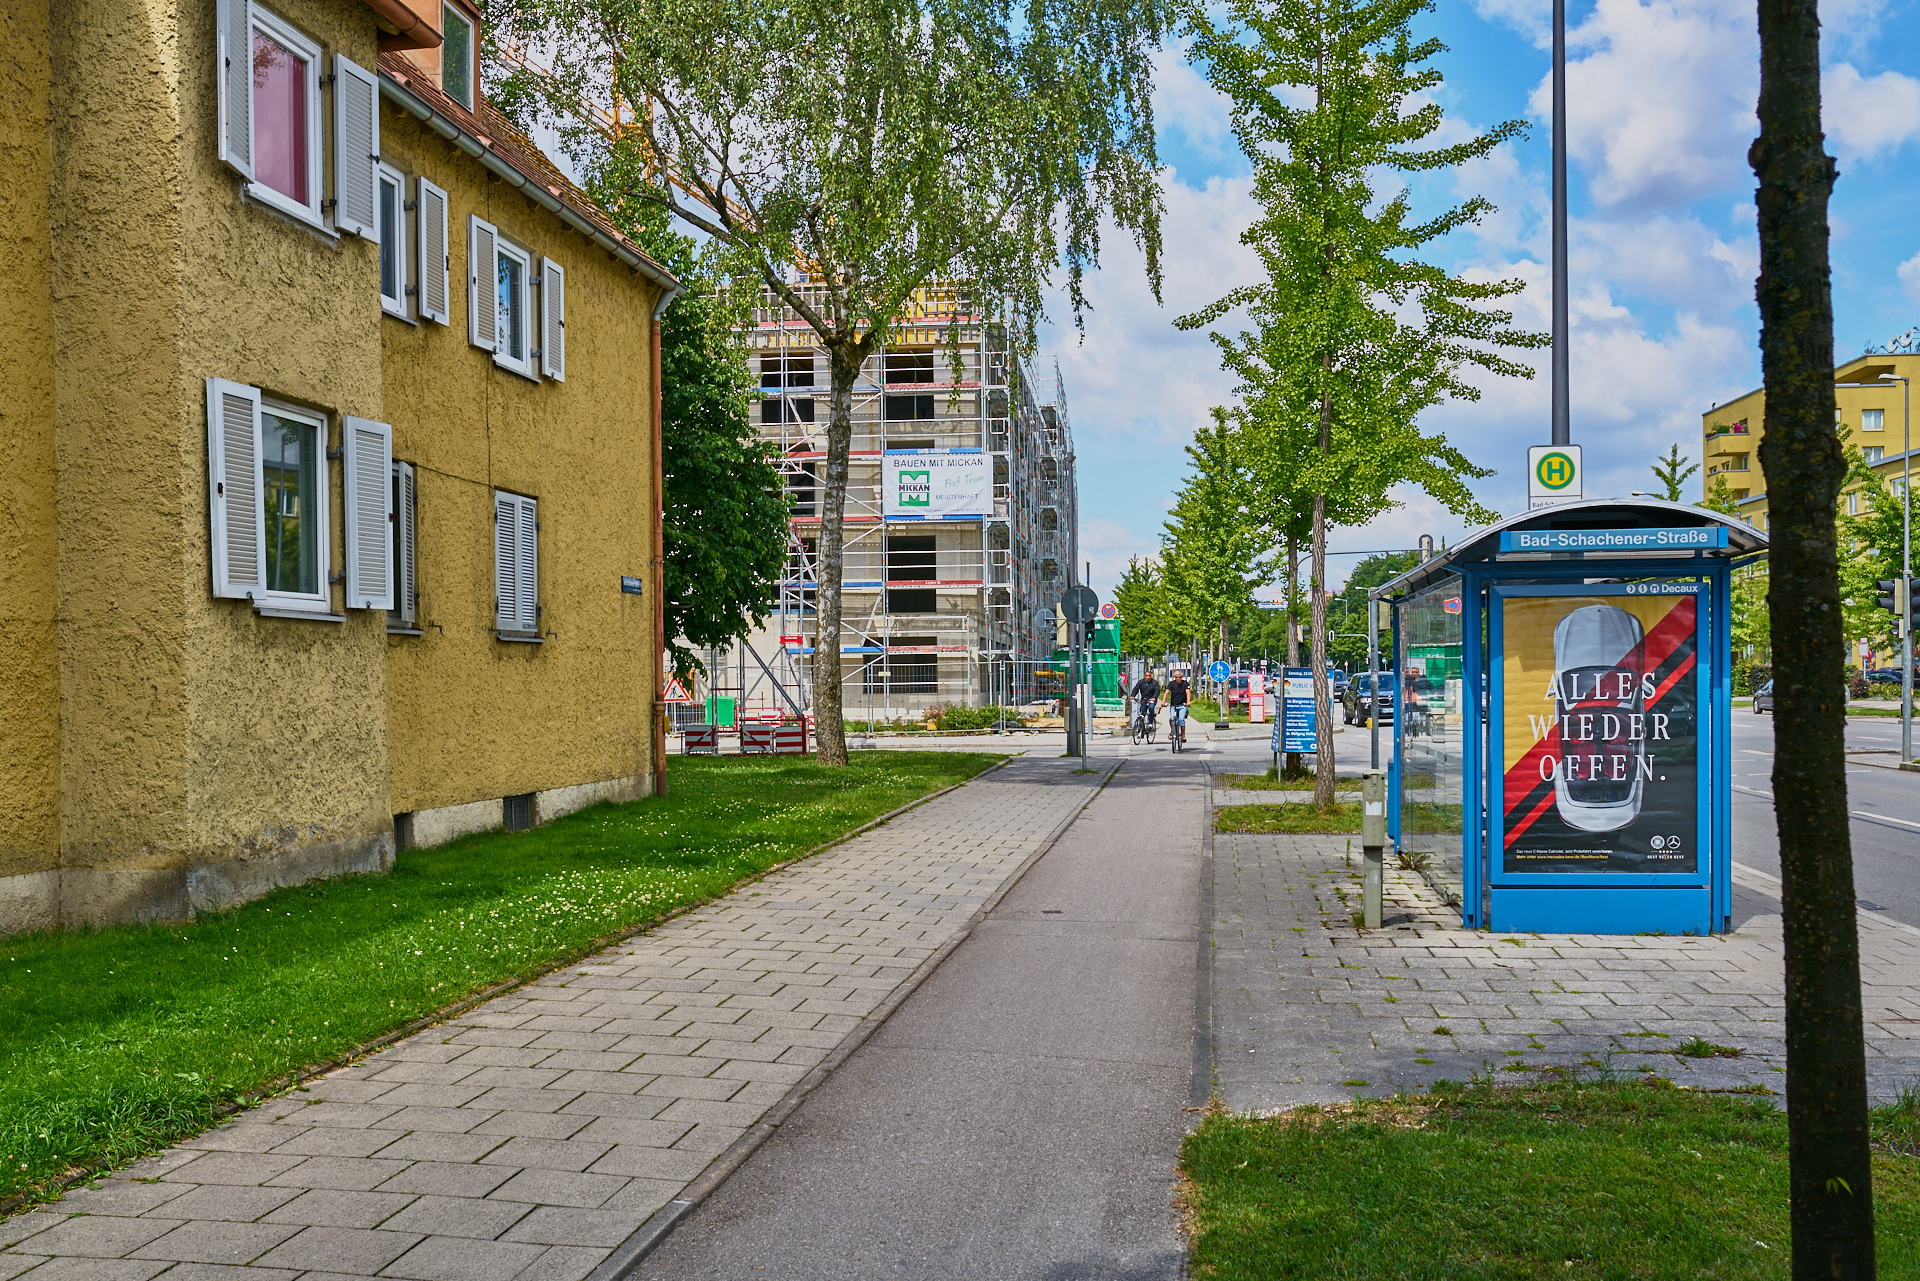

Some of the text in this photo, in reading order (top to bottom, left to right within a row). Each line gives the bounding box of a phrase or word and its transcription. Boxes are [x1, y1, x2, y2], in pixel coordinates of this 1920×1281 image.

[893, 458, 983, 467] BAUEN MIT MICKAN
[1547, 461, 1565, 481] H
[944, 473, 984, 488] Profi Team
[1520, 530, 1708, 547] Bad-Schachener-Straße
[1661, 583, 1699, 593] Decaux
[1543, 672, 1657, 700] ALLES
[1528, 713, 1671, 741] WIEDER
[1539, 754, 1667, 782] OFFEN.
